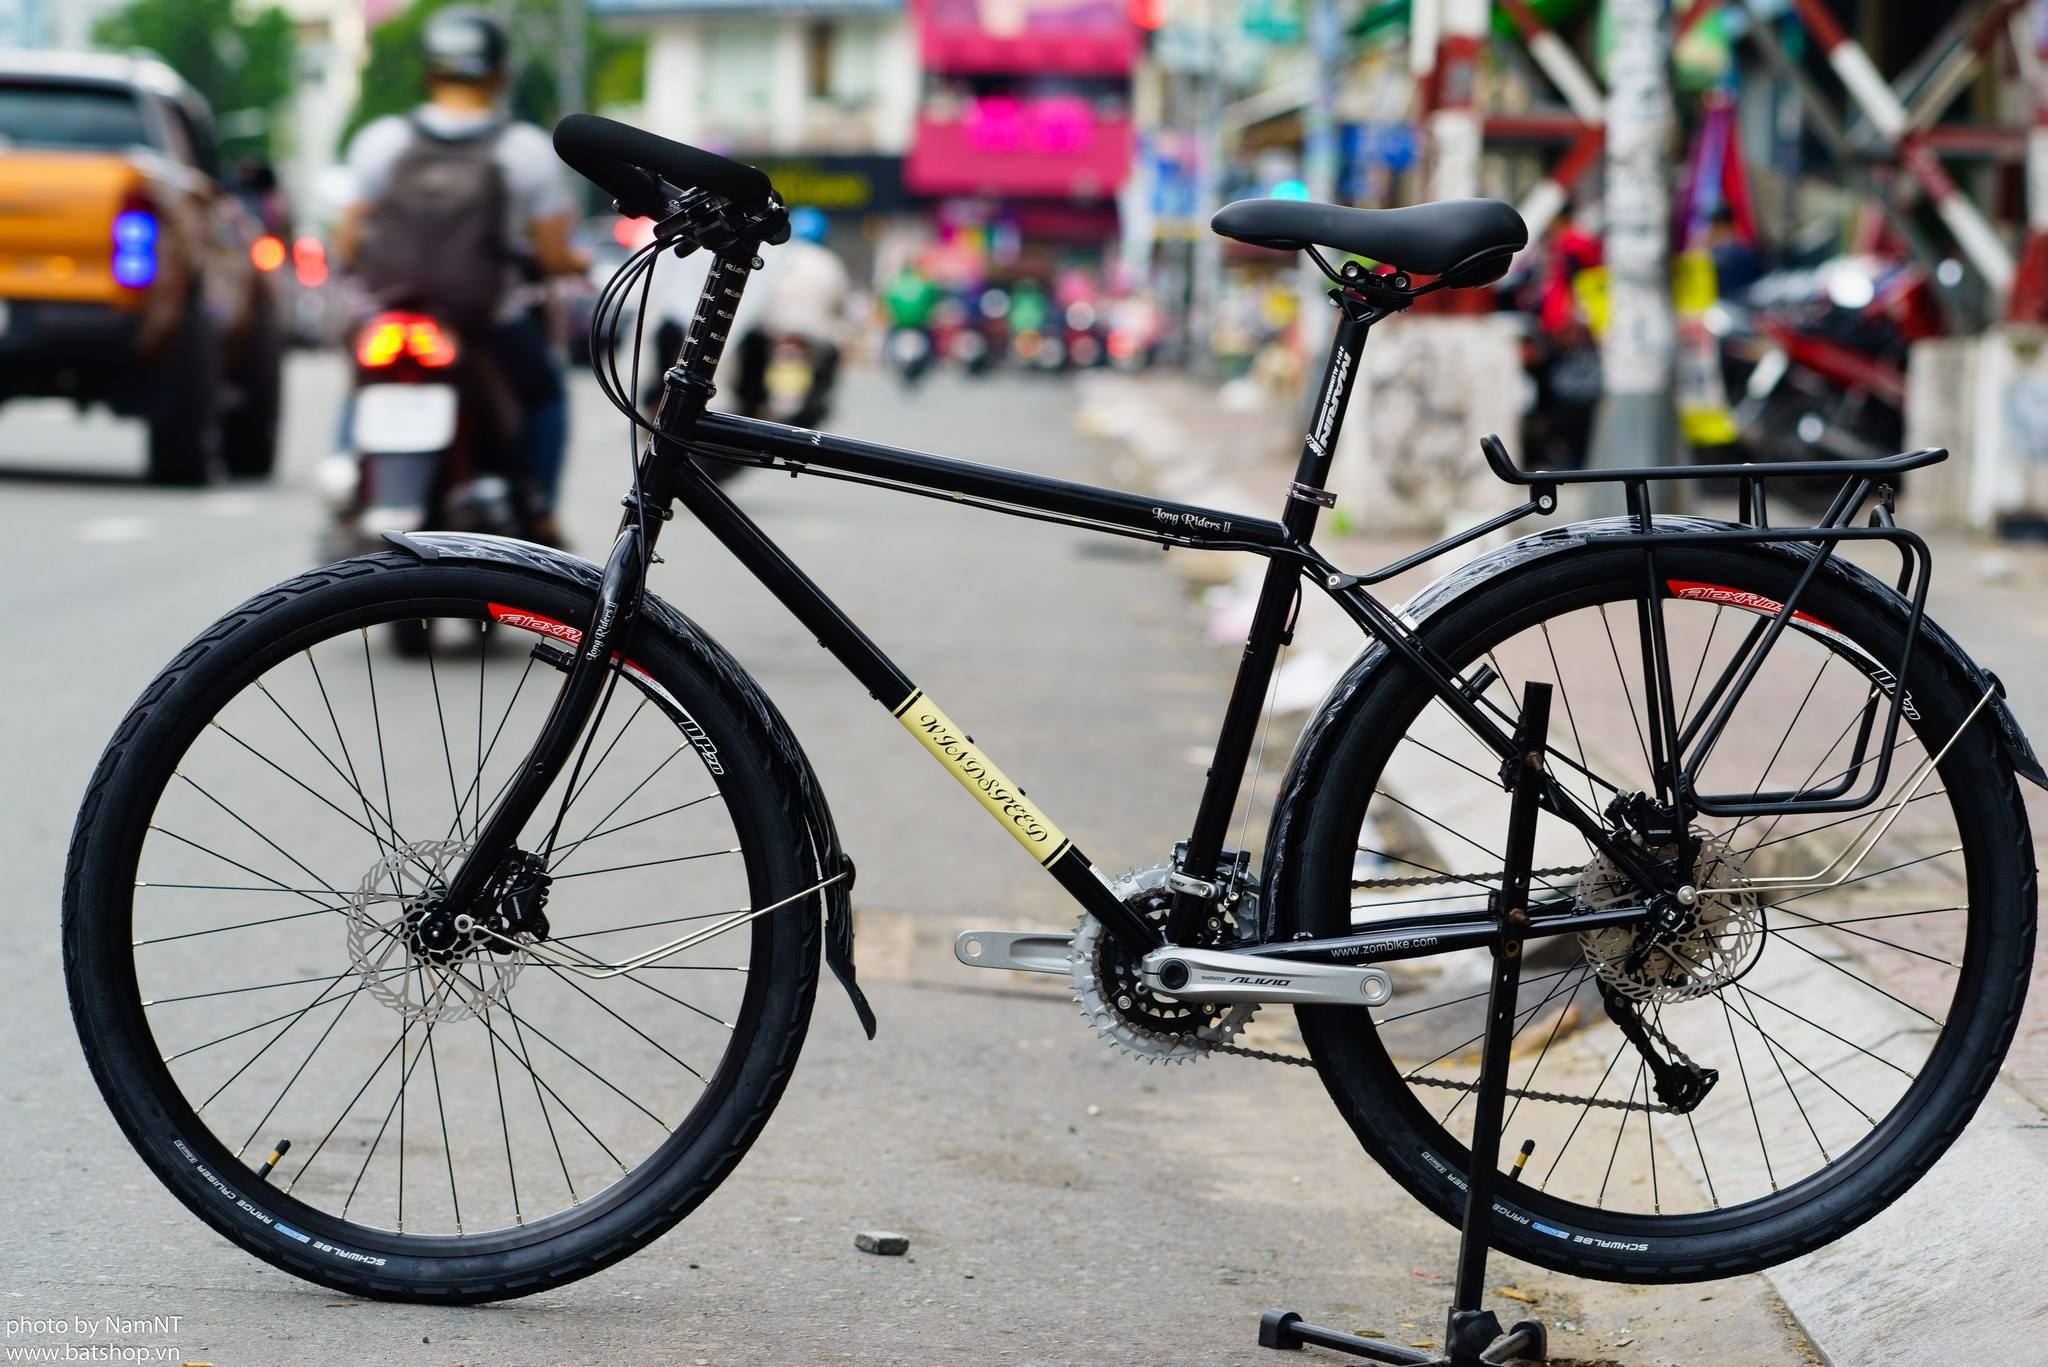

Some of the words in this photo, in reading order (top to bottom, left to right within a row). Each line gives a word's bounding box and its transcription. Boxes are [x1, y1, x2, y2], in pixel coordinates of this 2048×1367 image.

[1319, 351, 1351, 449] MARIN
[1152, 507, 1179, 526] Long
[1181, 513, 1221, 531] Riders
[1223, 521, 1232, 533] II
[595, 609, 614, 639] Riders
[586, 640, 605, 660] Long
[678, 720, 724, 775] DP20
[920, 714, 1048, 842] WINDSPEED
[1331, 935, 1437, 958] www.zombike.com
[1229, 976, 1291, 987] ALIVIO
[197, 1165, 236, 1200] CRUISER
[236, 1199, 274, 1225] RANGE
[1492, 1203, 1530, 1225] RANGE
[313, 1241, 388, 1266] SCHWALBE
[1573, 1234, 1649, 1251] SCHWALBE
